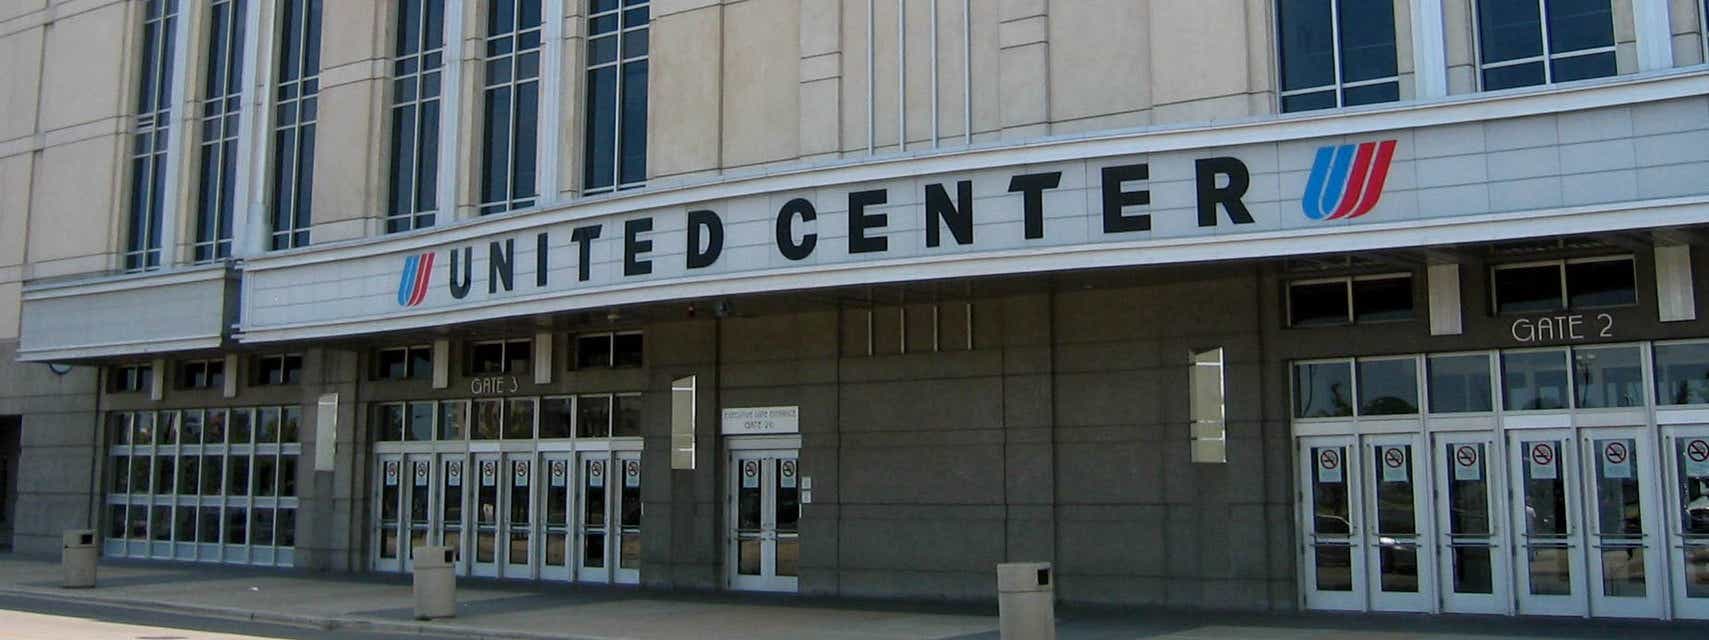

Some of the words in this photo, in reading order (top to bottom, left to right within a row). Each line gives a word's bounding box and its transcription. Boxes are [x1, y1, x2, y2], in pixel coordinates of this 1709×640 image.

[449, 208, 724, 299] UNITED
[775, 156, 1255, 261] CENTER
[1511, 314, 1584, 342] GATE
[1597, 313, 1613, 337] 2
[471, 376, 504, 394] GATE
[510, 375, 520, 393] 3
